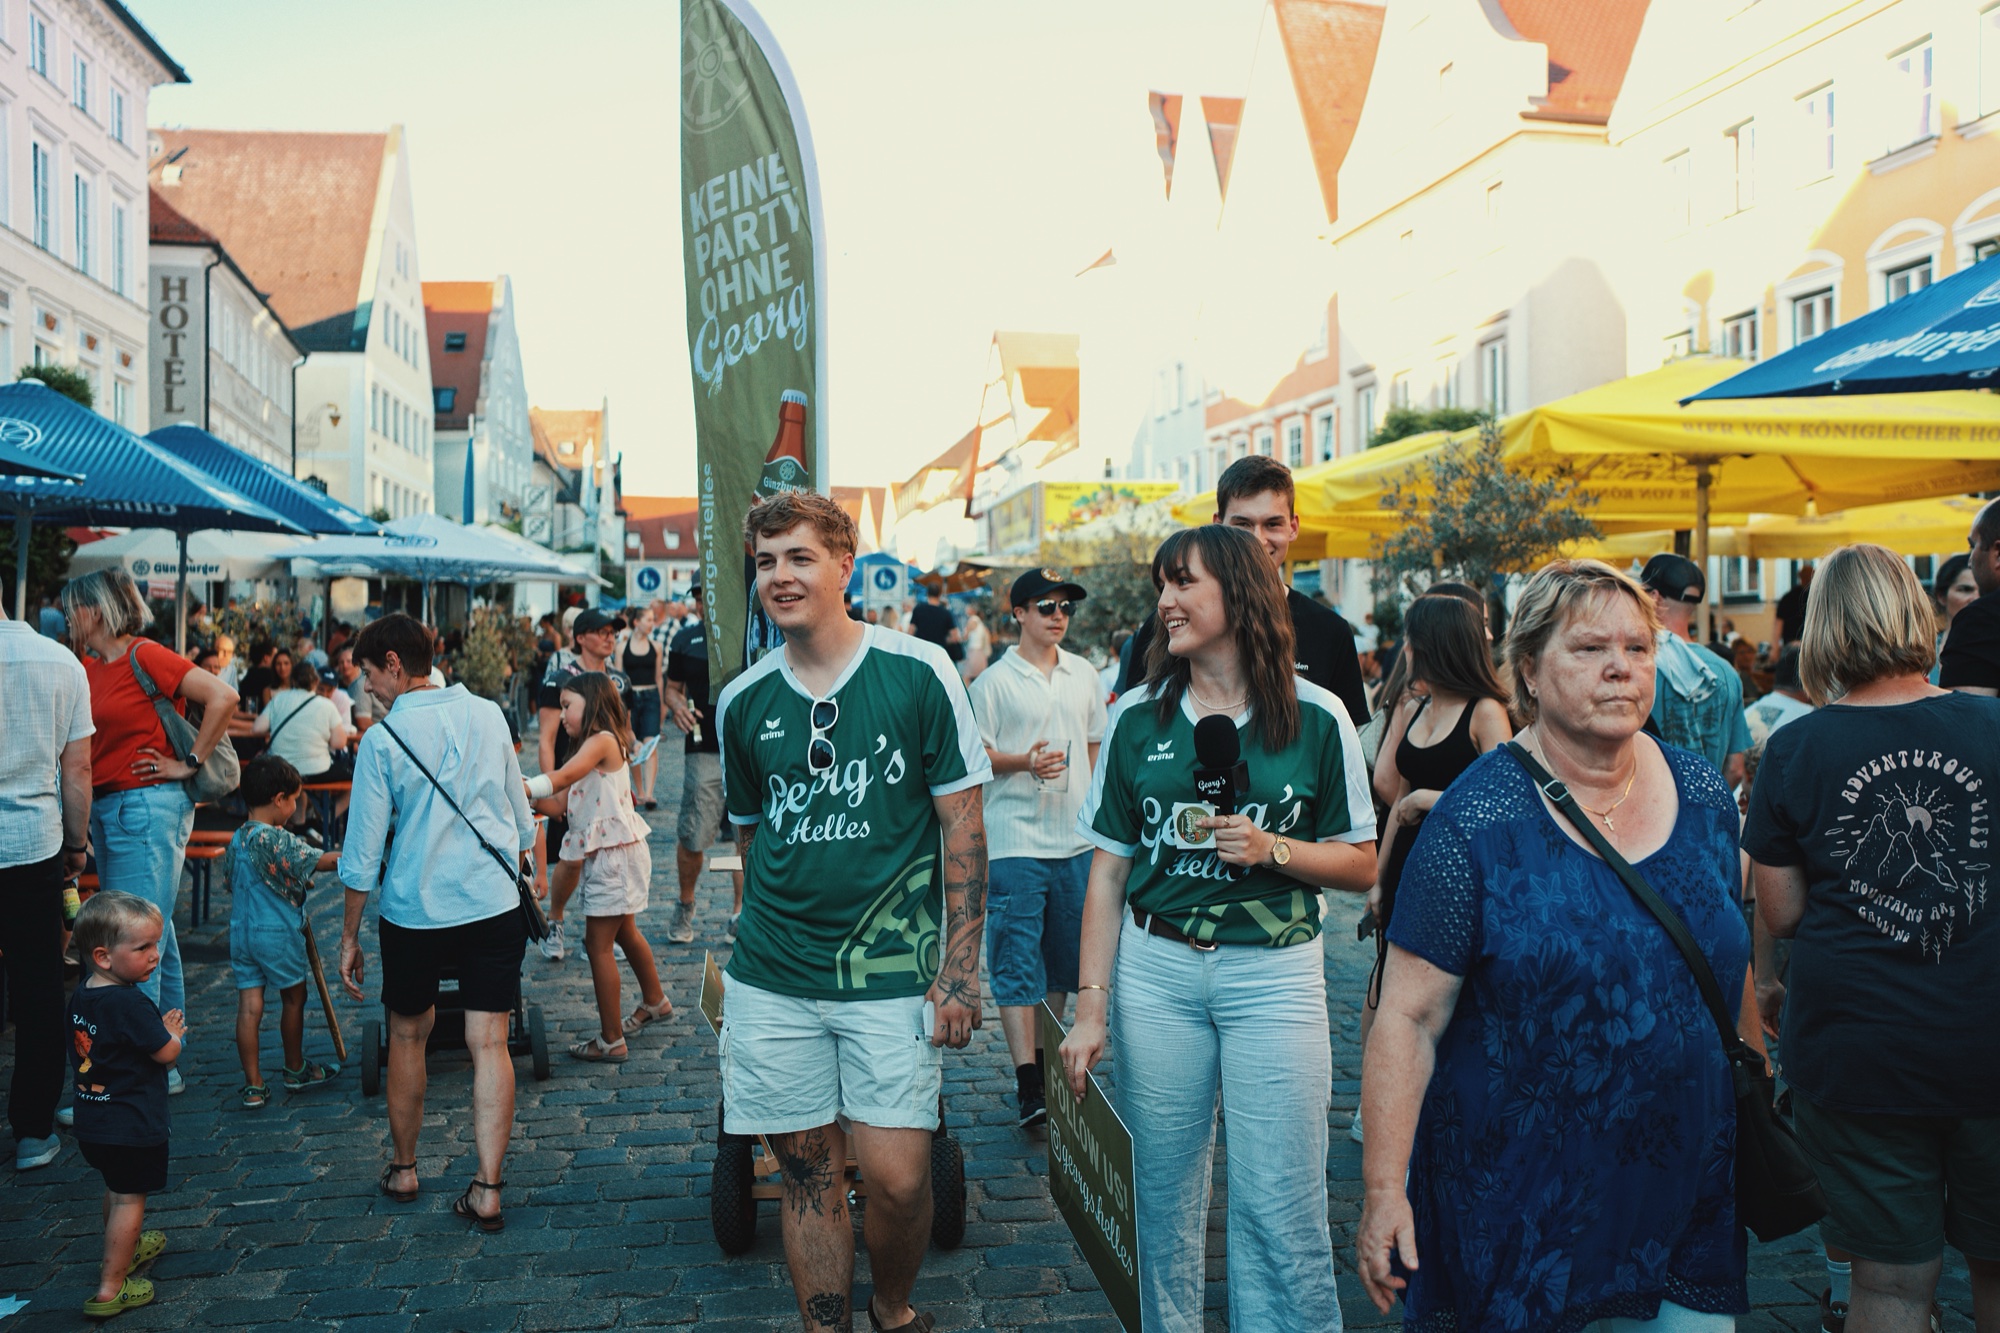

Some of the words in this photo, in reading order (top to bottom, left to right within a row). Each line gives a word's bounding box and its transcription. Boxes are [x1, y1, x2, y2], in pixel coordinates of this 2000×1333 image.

[689, 148, 791, 234] KEINE
[693, 186, 800, 278] PARTY
[700, 242, 794, 319] OHNE
[159, 275, 189, 415] HOTEL
[693, 279, 811, 398] Georg
[1743, 421, 1791, 438] VON
[1799, 419, 1963, 442] KÖNIGLICHER
[760, 729, 785, 741] erima
[1147, 752, 1175, 762] erima
[1197, 775, 1226, 792] Georg's
[1841, 749, 1983, 804] ADVENTUROUS
[1968, 798, 1989, 849] LIFE
[786, 812, 871, 845] Helles
[1849, 879, 1924, 923] MOUNTAINS
[1930, 902, 1956, 920] ARE
[1858, 906, 1910, 943] CALLING
[1050, 1064, 1100, 1174] FOLLOW
[1102, 1152, 1130, 1221] US!
